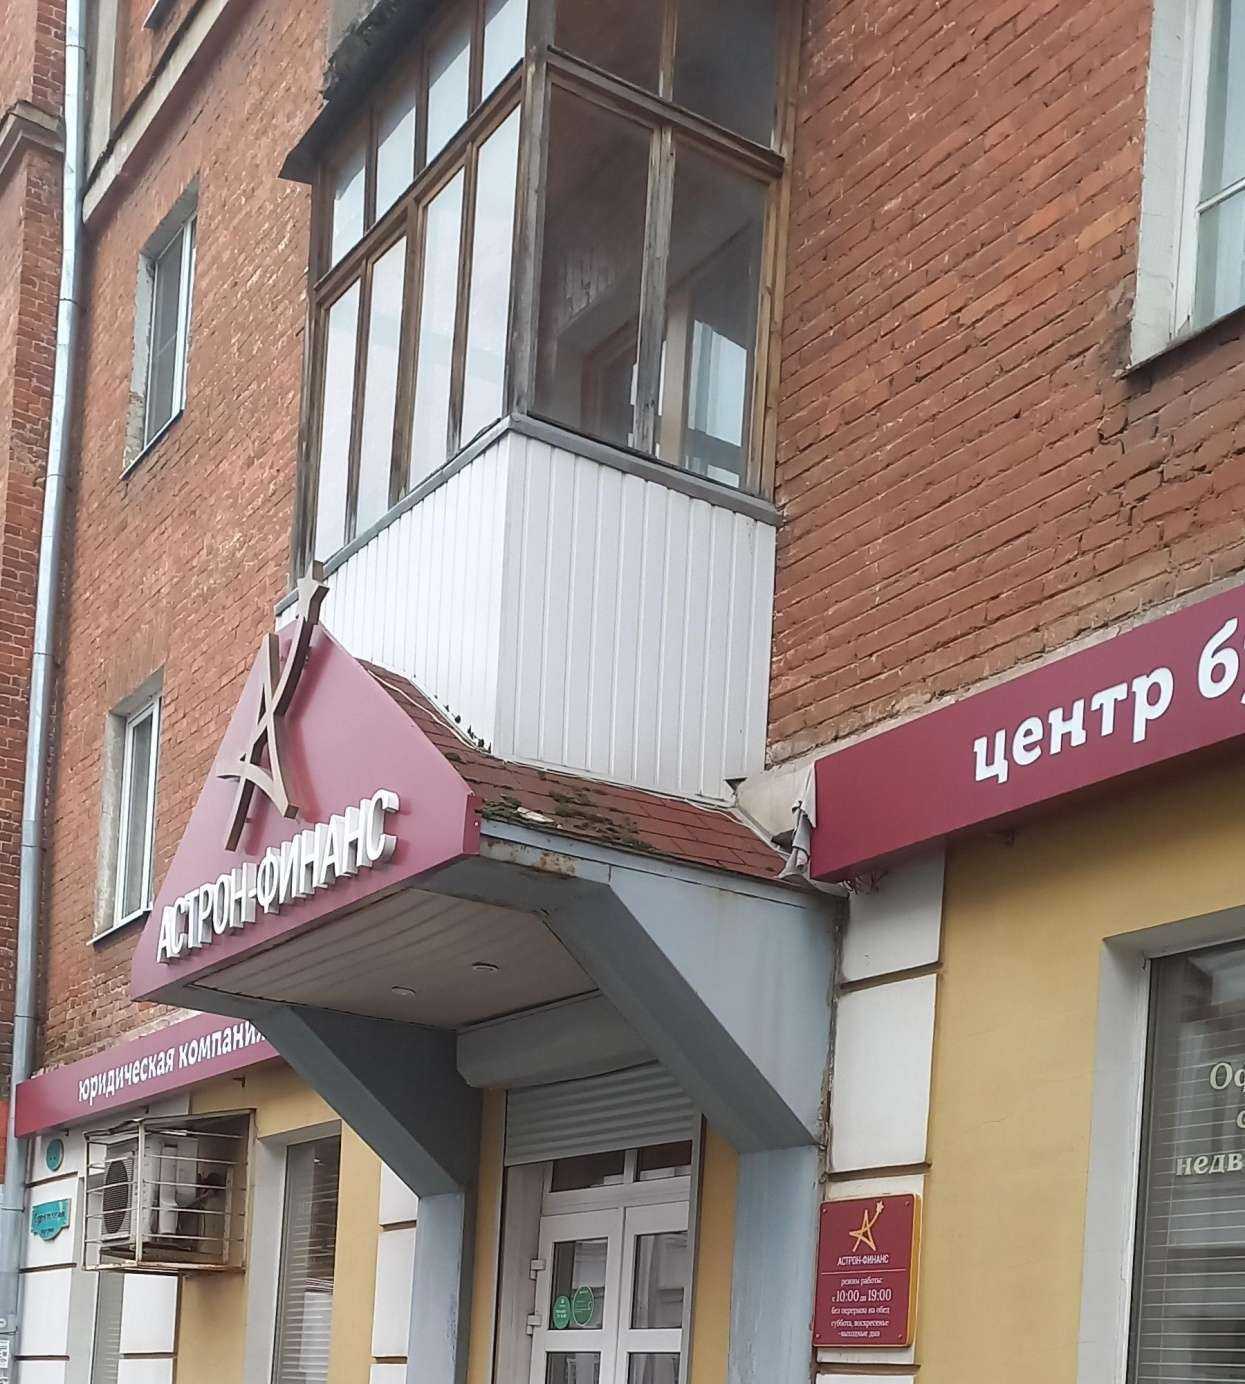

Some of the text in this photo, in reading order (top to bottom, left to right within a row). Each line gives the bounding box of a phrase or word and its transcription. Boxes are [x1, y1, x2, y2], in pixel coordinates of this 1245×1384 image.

[972, 616, 1245, 785] центр б
[156, 788, 401, 966] АСТРОН-ФИНАНС
[78, 1047, 176, 1106] юридическая
[837, 1254, 889, 1265] АСТРОН-ФИНАНС
[836, 1289, 860, 1302] 10:00
[868, 1288, 892, 1301] 19:00
